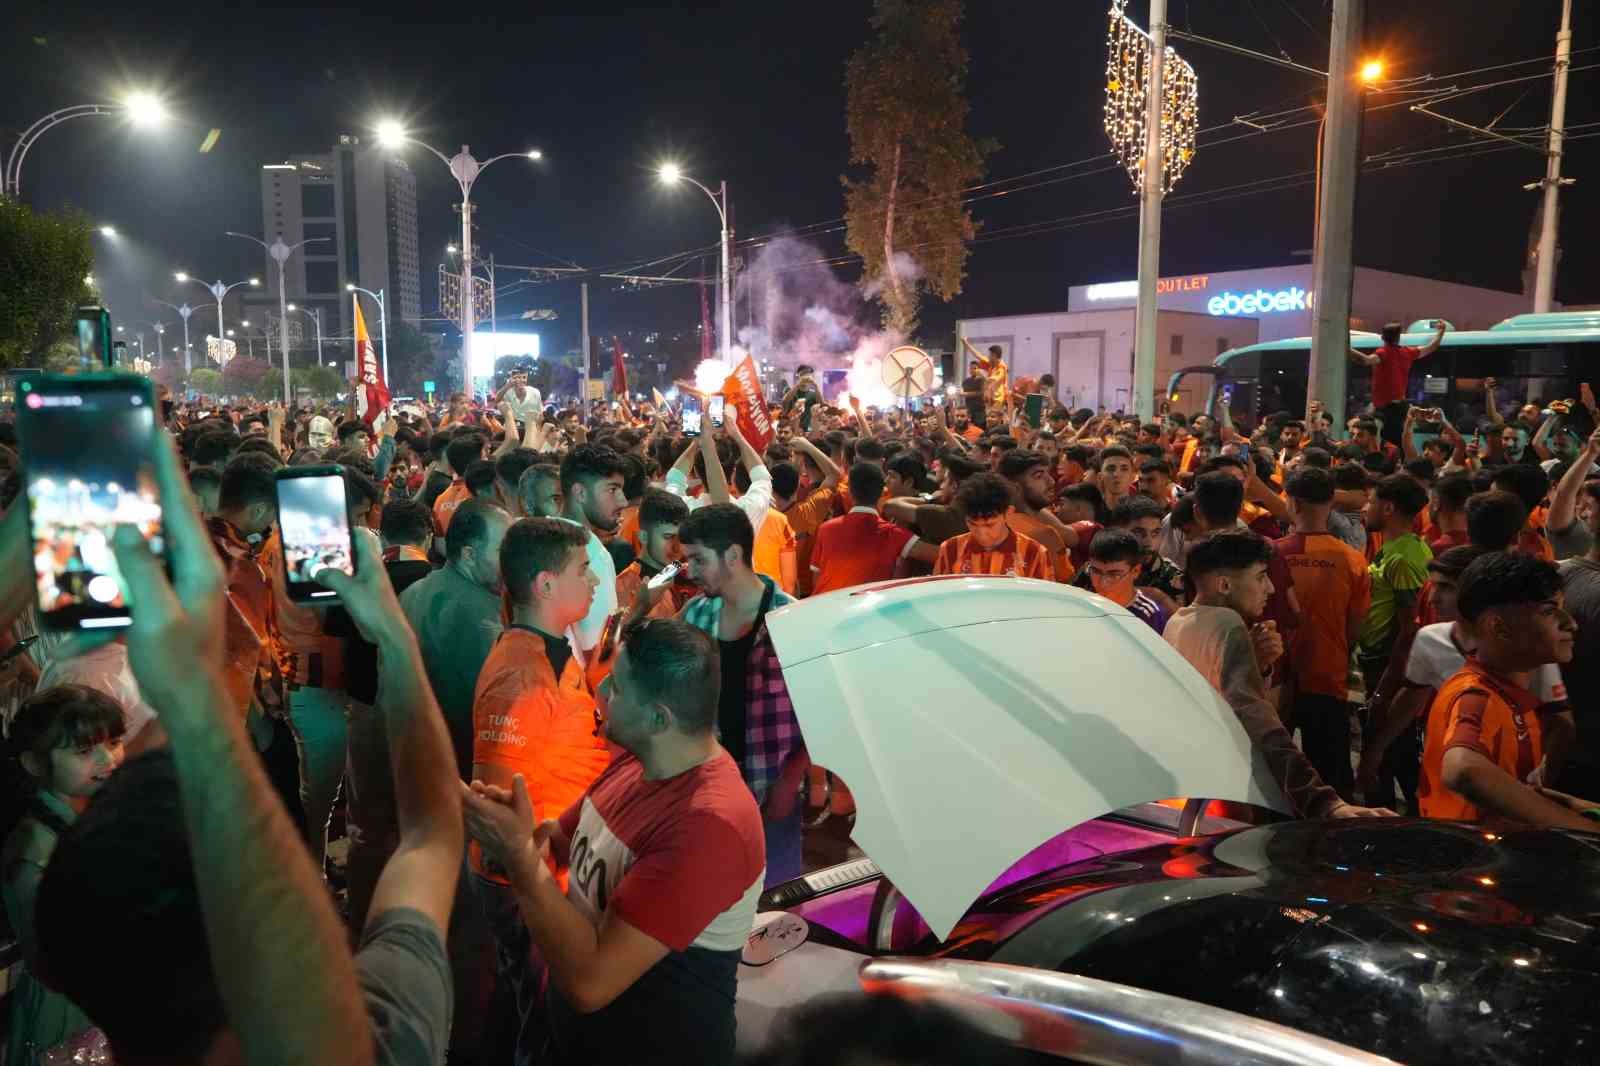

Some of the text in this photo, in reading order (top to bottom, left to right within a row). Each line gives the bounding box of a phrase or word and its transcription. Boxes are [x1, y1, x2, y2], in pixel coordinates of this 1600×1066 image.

[1156, 276, 1209, 293] OUTLET
[1207, 286, 1305, 316] ebebek
[487, 714, 520, 731] TUNÇ
